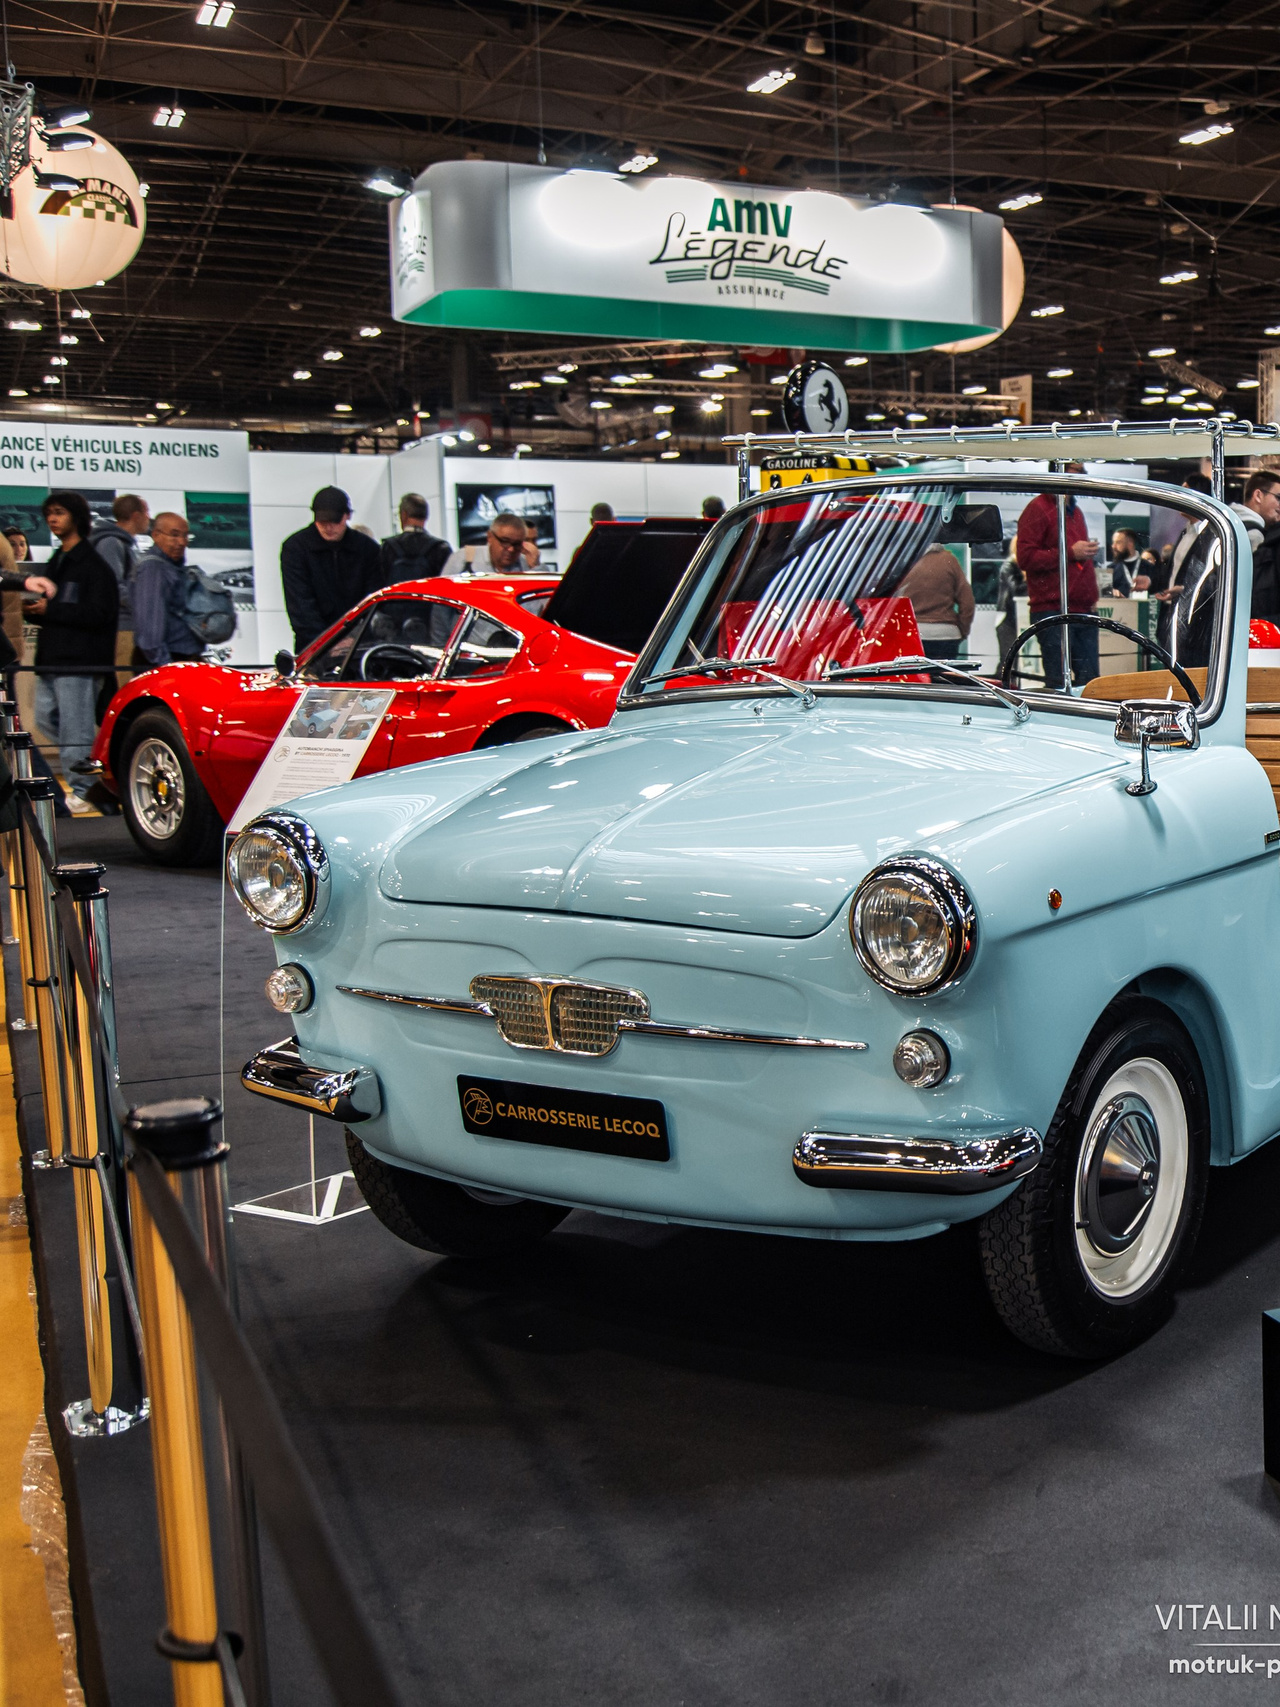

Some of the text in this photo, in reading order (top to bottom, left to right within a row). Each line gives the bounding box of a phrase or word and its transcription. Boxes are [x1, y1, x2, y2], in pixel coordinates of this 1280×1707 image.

[86, 178, 128, 206] MANS
[718, 285, 787, 301] ASSURANCE
[0, 434, 220, 459] ANCE VÉHICULES ANCIENS
[54, 456, 75, 472] DE
[81, 457, 100, 472] 15
[104, 457, 142, 477] ANS)
[766, 457, 819, 470] GASOLINE
[495, 1101, 661, 1138] CARROSSERIE LECOQ
